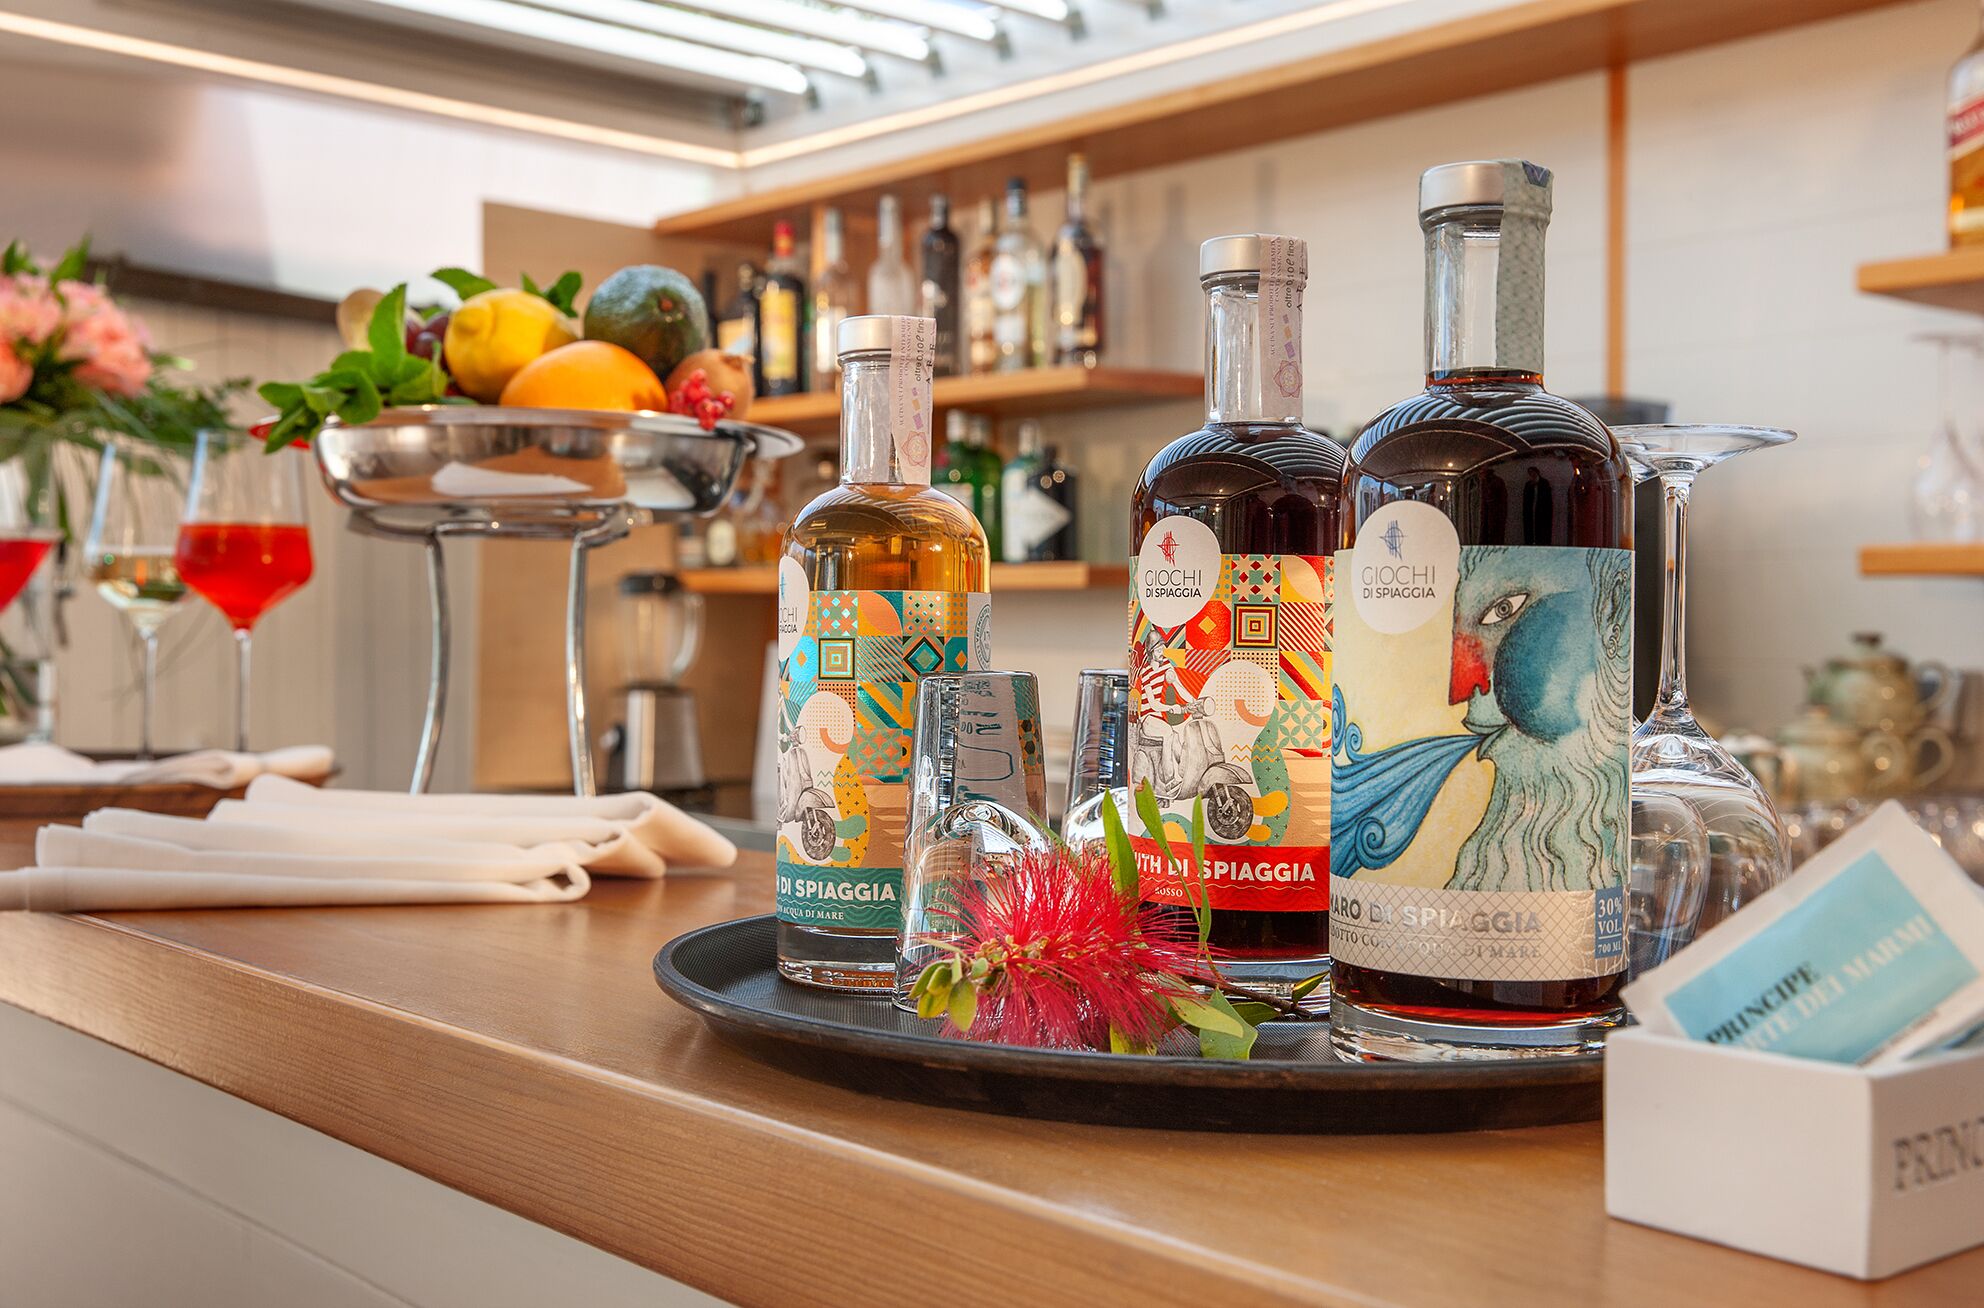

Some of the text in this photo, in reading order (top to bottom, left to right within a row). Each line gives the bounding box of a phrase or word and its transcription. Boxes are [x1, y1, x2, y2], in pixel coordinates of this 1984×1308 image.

[1145, 569, 1201, 586] GIOCHI
[1362, 565, 1435, 585] GIOCHI
[1146, 588, 1202, 598] DI SPIAGGIA
[1363, 587, 1436, 598] DI SPIAGGIA
[1168, 857, 1188, 878] DI
[1197, 859, 1316, 882] SPIAGGIA
[781, 876, 792, 896] DI
[795, 879, 897, 902] SPIAGGIA
[805, 909, 815, 918] DI
[816, 911, 845, 920] MARE
[1370, 901, 1393, 925] DI
[1402, 905, 1543, 933] SPIAGGIA
[1598, 896, 1622, 918] 30%
[1842, 913, 1935, 985] MARMI
[1705, 962, 1822, 1045] PRINCIPE
